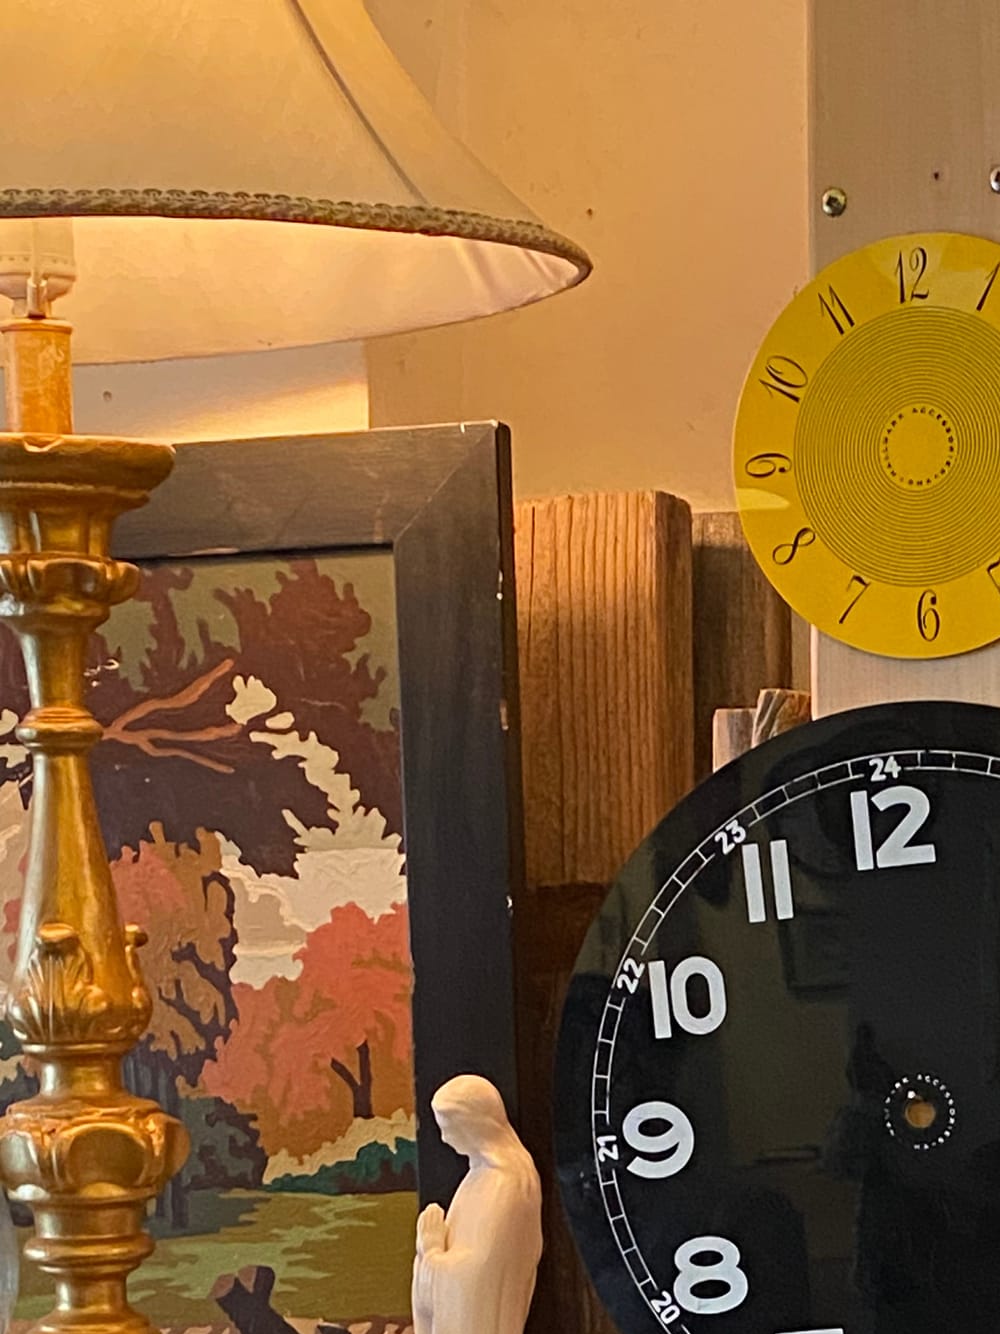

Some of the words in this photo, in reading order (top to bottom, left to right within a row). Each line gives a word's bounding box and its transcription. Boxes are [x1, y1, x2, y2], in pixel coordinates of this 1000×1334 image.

[896, 247, 929, 304] 12
[976, 262, 1000, 311] 1
[818, 286, 855, 335] 11
[759, 356, 807, 403] 10
[745, 453, 790, 478] 9
[773, 524, 816, 565] 8
[839, 575, 871, 624] 7
[917, 590, 940, 642] 6
[869, 756, 901, 782] 24
[715, 820, 748, 854] 23
[851, 786, 936, 870] 12
[743, 840, 794, 923] 11
[616, 957, 645, 993] 22
[648, 957, 726, 1038] 10
[597, 1135, 619, 1161] 21
[623, 1101, 694, 1178] 9
[674, 1236, 748, 1314] 8
[651, 1291, 681, 1325] 20
